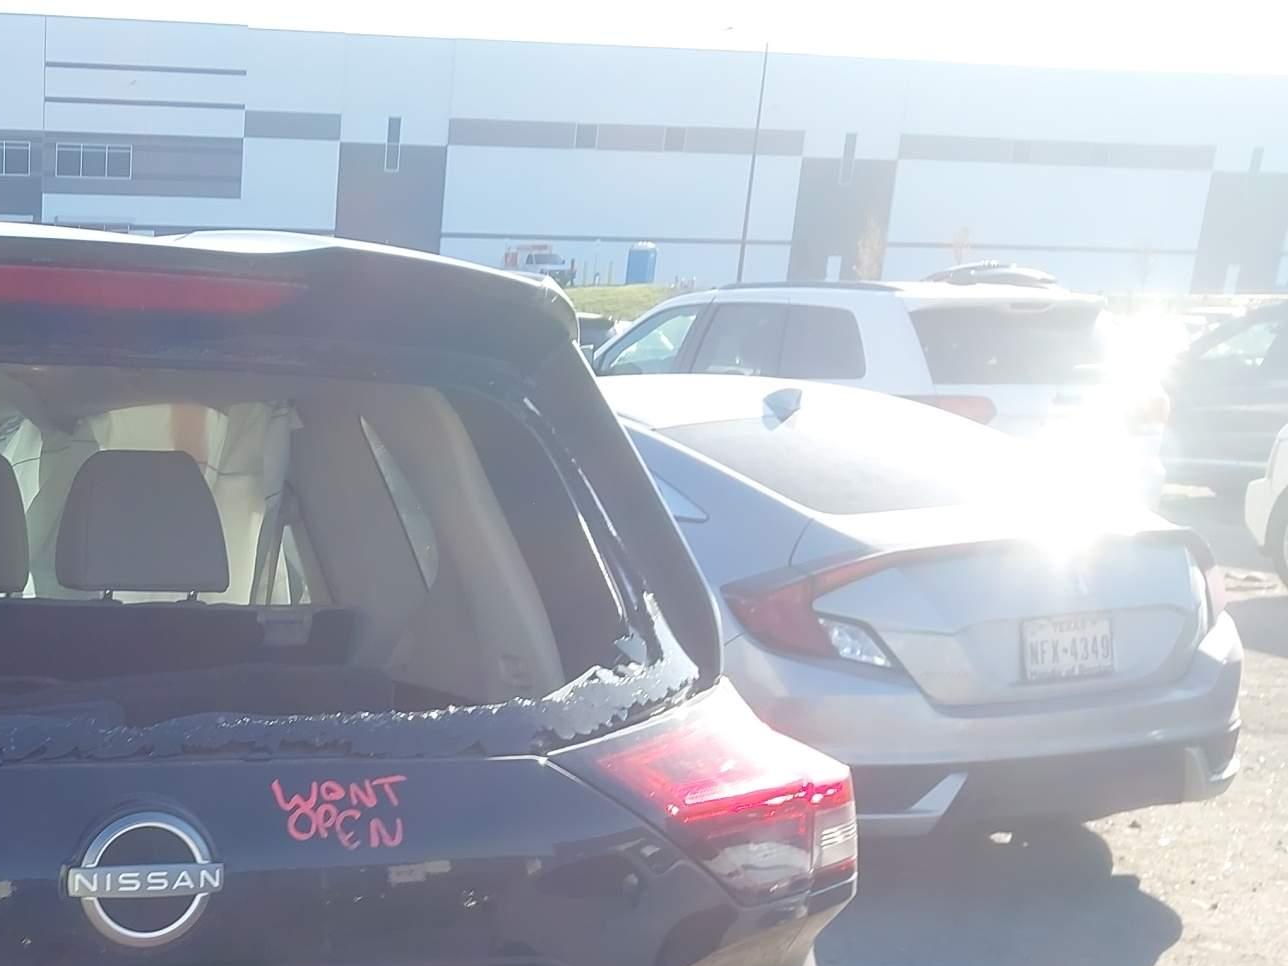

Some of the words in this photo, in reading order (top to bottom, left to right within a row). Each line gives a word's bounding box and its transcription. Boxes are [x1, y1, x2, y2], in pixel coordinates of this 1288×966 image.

[270, 774, 408, 811] WONT
[287, 803, 404, 850] OPEN
[73, 868, 221, 893] NISSAN
